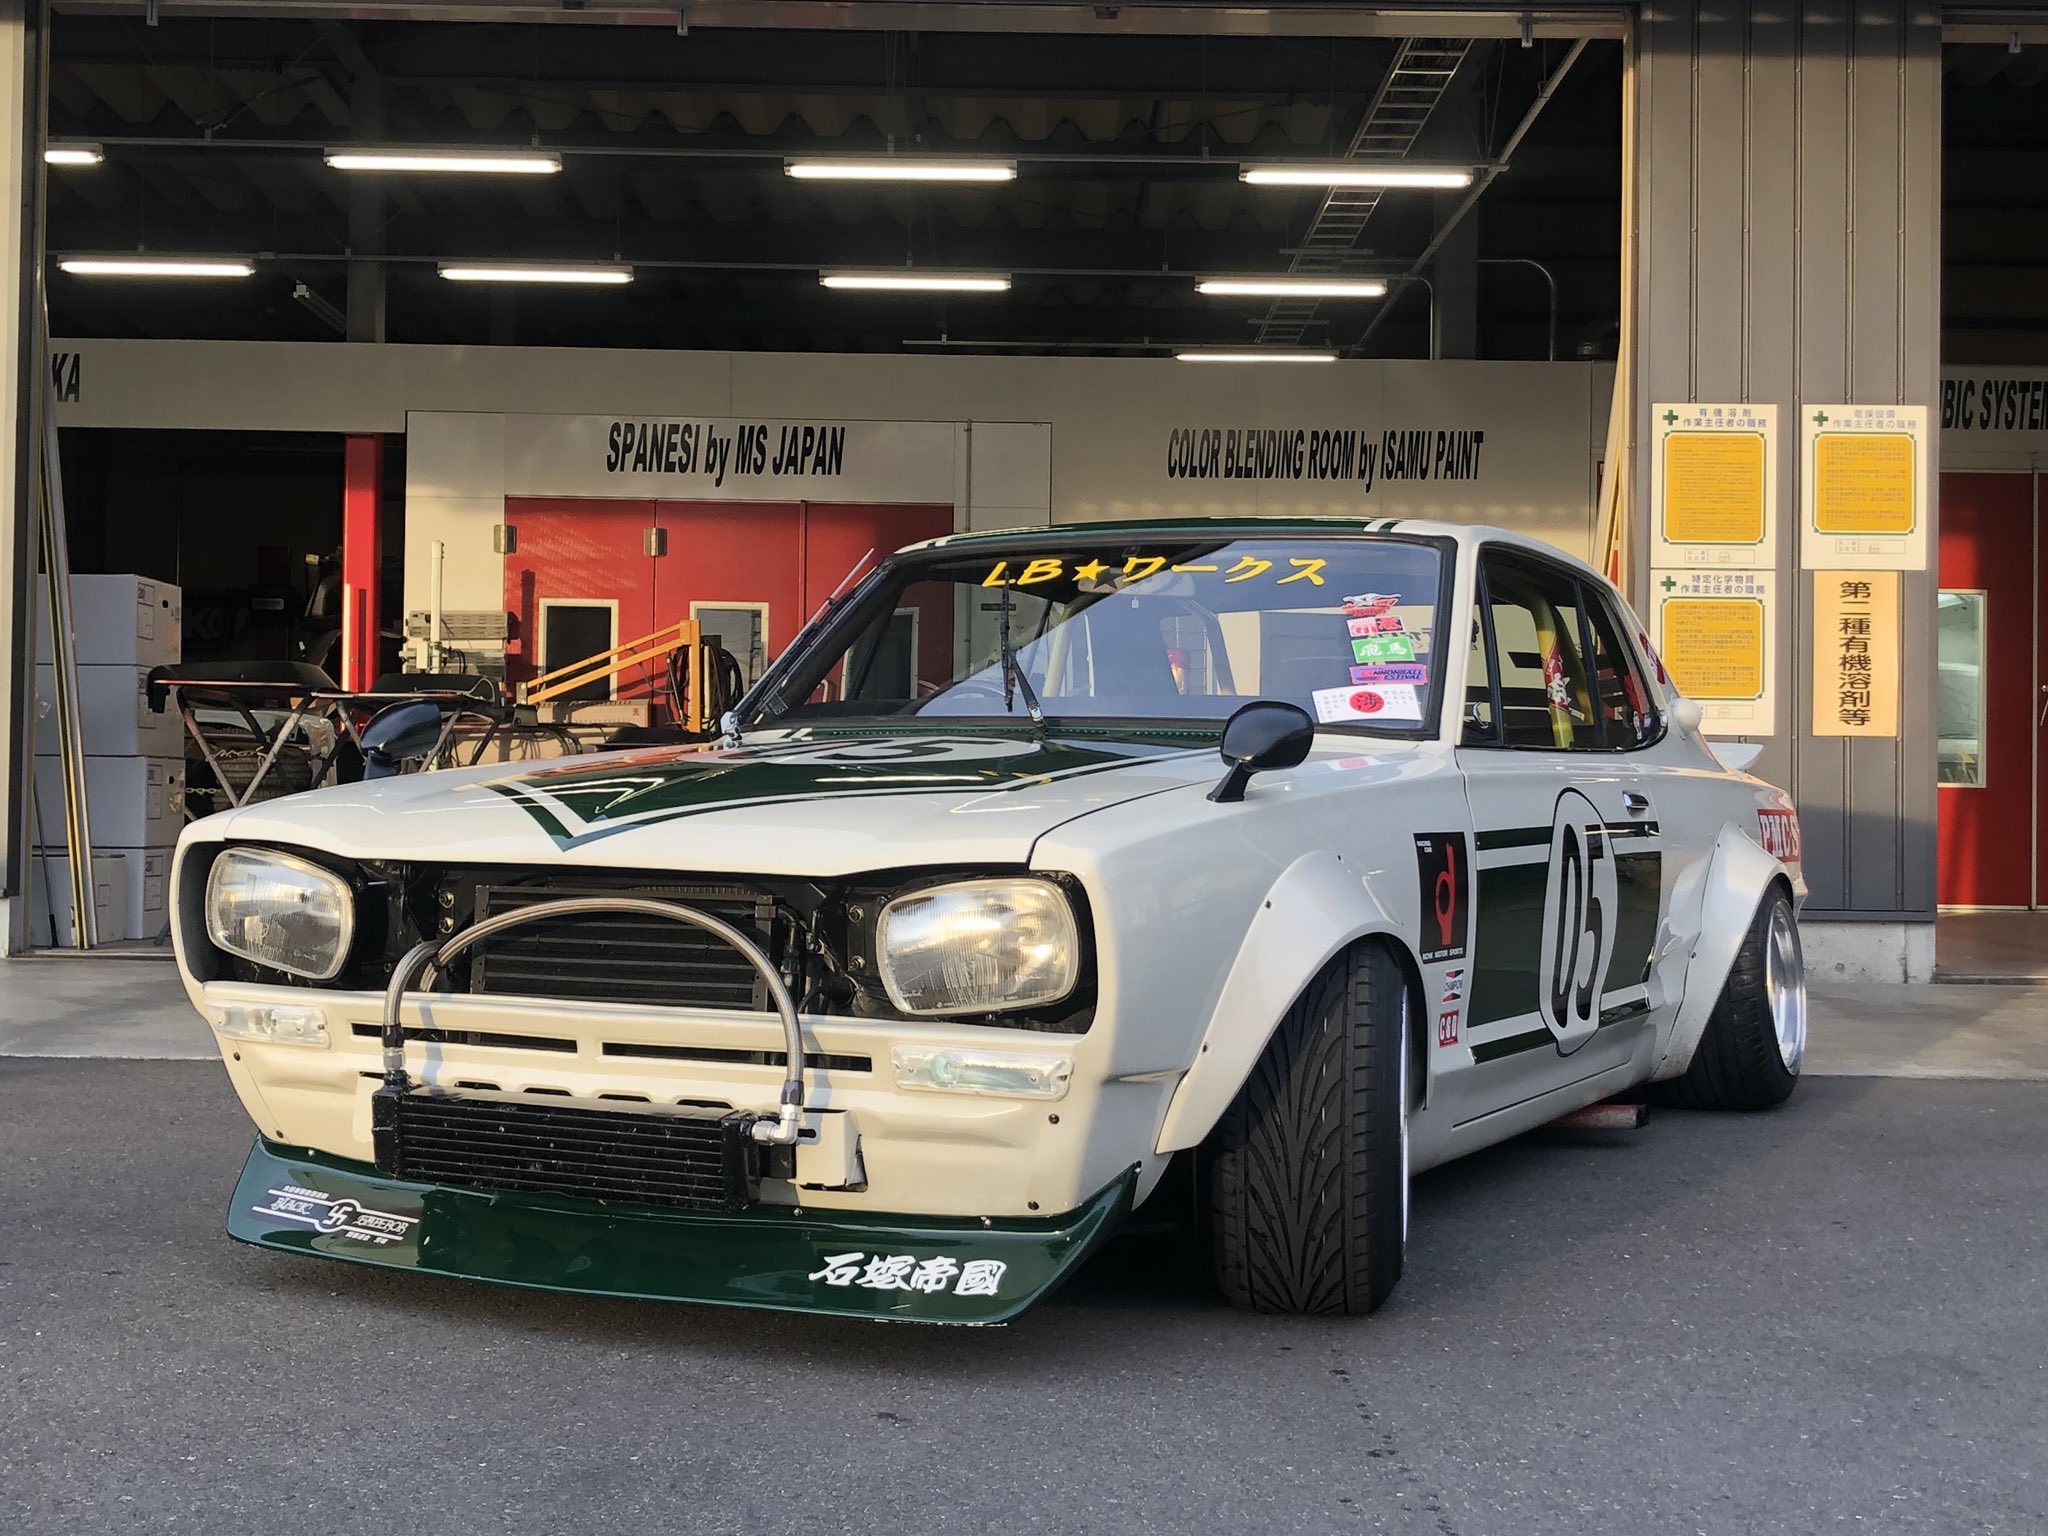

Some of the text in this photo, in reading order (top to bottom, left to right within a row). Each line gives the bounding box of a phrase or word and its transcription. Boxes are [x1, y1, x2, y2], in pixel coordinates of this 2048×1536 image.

[607, 422, 845, 487] SPANESI by MS JAPAN
[1168, 429, 1484, 493] COLOR BLENDING ROOM by ISAMU PAINT
[1839, 581, 1872, 726] 第二種有機溶剤等
[1551, 823, 1604, 1029] 05
